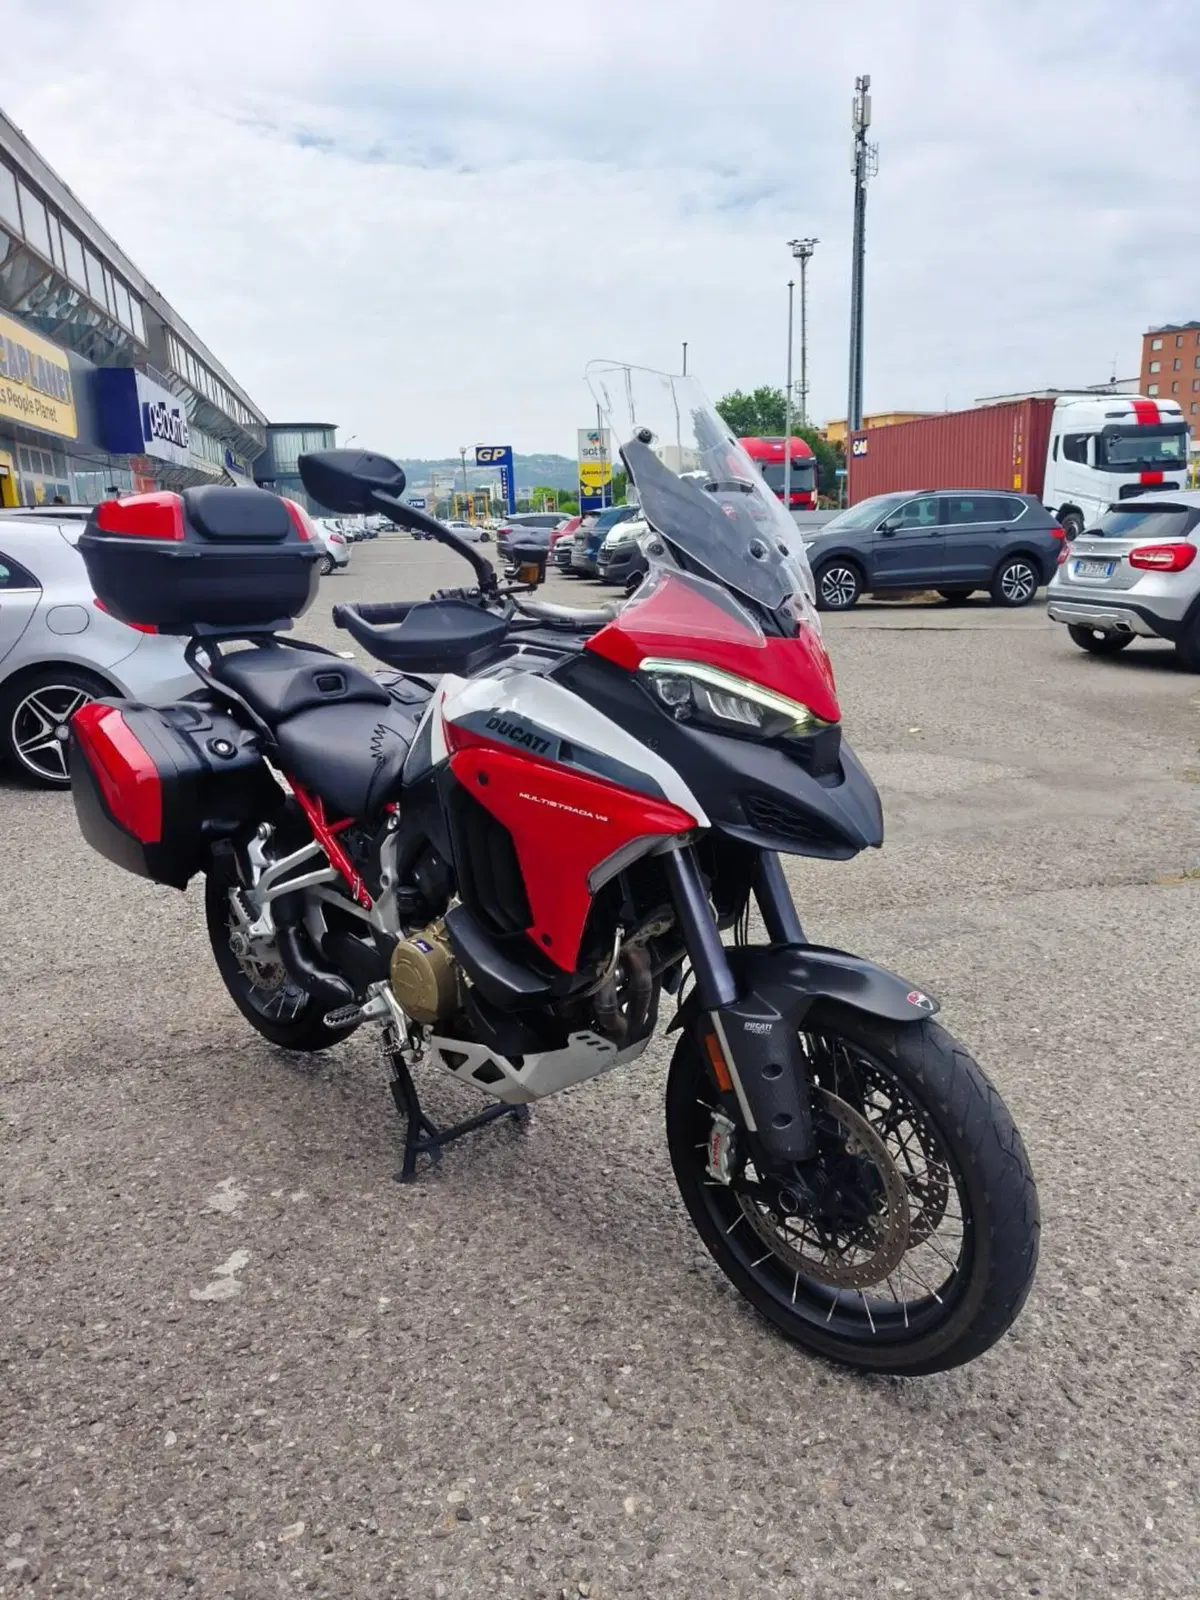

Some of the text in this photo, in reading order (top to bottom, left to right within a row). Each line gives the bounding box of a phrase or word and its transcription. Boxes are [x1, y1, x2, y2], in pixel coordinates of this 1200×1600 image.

[478, 448, 506, 461] GP
[486, 717, 551, 754] DUCATI
[519, 792, 593, 817] MULTISTRADA
[744, 1021, 773, 1031] DUCATI
